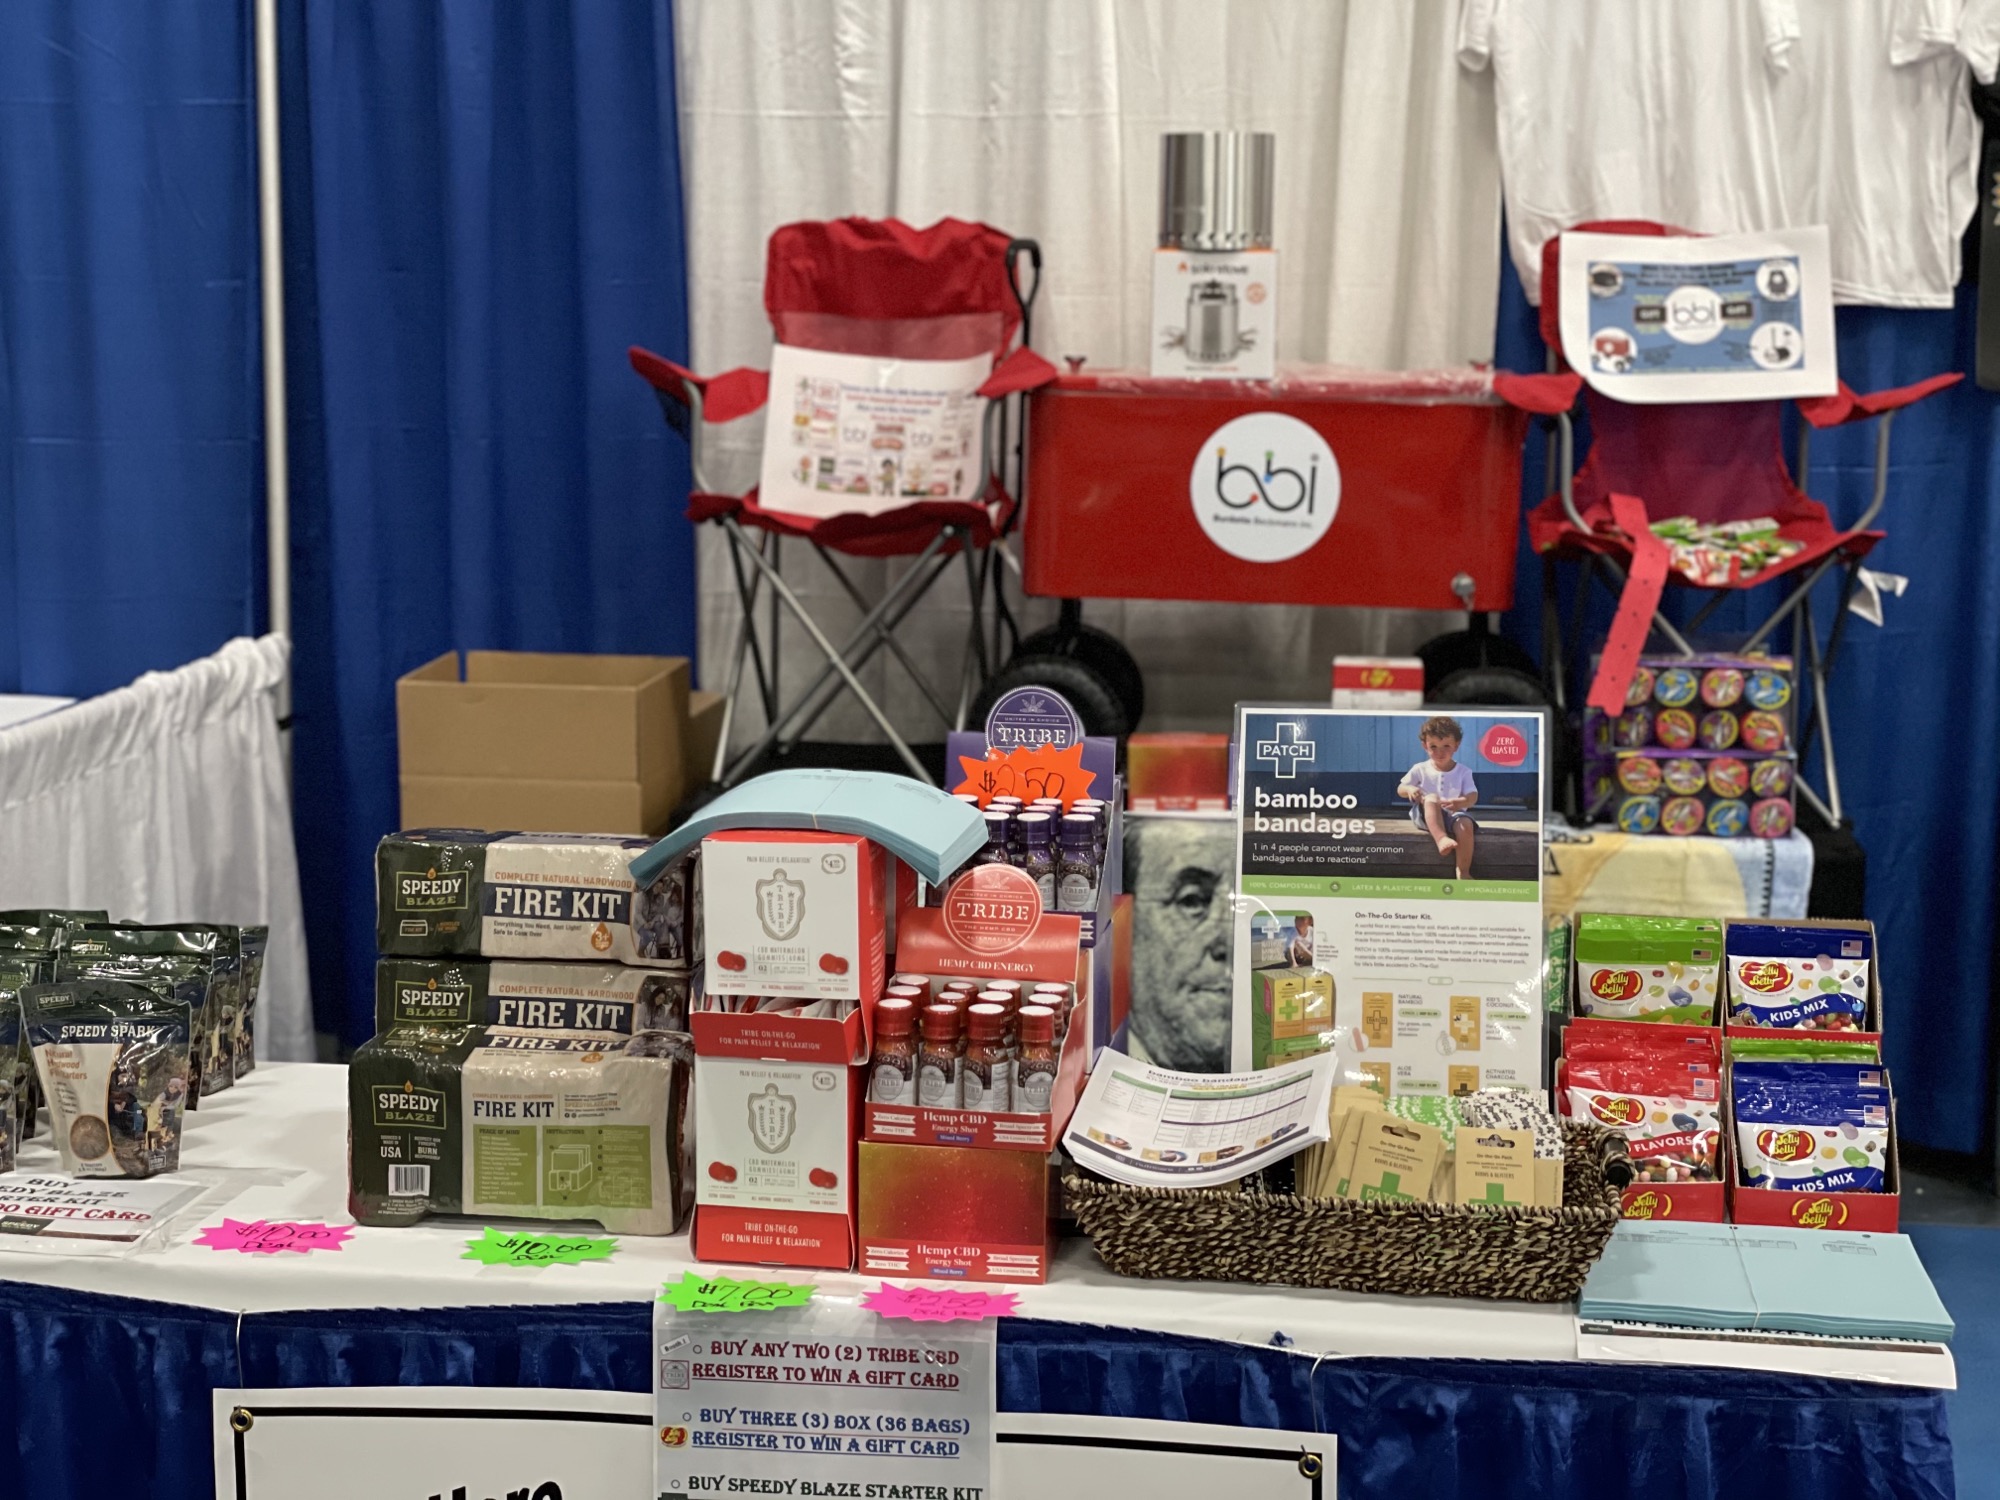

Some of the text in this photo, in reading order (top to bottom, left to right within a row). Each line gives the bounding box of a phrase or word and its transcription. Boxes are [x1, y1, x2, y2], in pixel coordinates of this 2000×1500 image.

[998, 728, 1066, 743] TRIBE
[1496, 737, 1515, 745] ZERO
[1263, 744, 1309, 757] PATCH
[1491, 745, 1519, 755] WASTE!
[1255, 787, 1358, 809] bamboo
[1255, 811, 1376, 838] bandages
[1278, 844, 1309, 853] people
[1253, 854, 1295, 864] bandages
[402, 879, 461, 895] SPEEDY
[495, 872, 632, 888] COMPLETE NATURAL HARDWOOD
[406, 896, 457, 906] BLAZE
[494, 887, 622, 919] FIRE KIT
[957, 903, 1029, 920] TRIBE
[494, 921, 523, 929] Everything
[939, 958, 1035, 973] HEMP CBD ENERGY
[1607, 970, 1629, 985] Jelly
[1749, 975, 1775, 992] Belly
[39, 995, 70, 1003] SPEEDY
[401, 989, 464, 1007] SPEEDY
[499, 985, 634, 1000] COMPLETE NATURAL HARDWOOD
[1598, 983, 1624, 1000] Belly
[406, 1008, 458, 1017] BLAZE
[498, 1000, 624, 1031] FIRE KIT
[1770, 999, 1829, 1022] KIDS MIX
[61, 1025, 157, 1038] SPEEDY SPARK
[741, 1029, 795, 1039] TRIBE ON-THE-GO
[488, 1037, 620, 1052] FIRE KIT
[782, 1042, 820, 1050] RELAXATION
[1148, 1070, 1199, 1083] bamboo
[379, 1094, 439, 1112] SPEEDY
[473, 1100, 516, 1118] FIRE
[523, 1102, 554, 1118] KIT
[1607, 1097, 1630, 1113] Jelly
[385, 1112, 435, 1122] BLAZE
[923, 1112, 987, 1125] Hemp CBD
[1601, 1110, 1626, 1125] Belly
[932, 1124, 978, 1134] Energy Shot
[1634, 1136, 1694, 1152] FLAVORS
[1776, 1129, 1800, 1145] Jelly
[380, 1146, 401, 1158] USA
[418, 1147, 437, 1155] BURN
[1773, 1145, 1796, 1161] Belly
[26, 1178, 82, 1188] BUY
[1792, 1172, 1855, 1192] KIDS MIX
[64, 1197, 107, 1205] KIT
[1634, 1191, 1658, 1208] Jelly
[1809, 1198, 1833, 1216] Jelly
[25, 1206, 151, 1219] GIFT CARD
[1624, 1205, 1653, 1220] Belly
[745, 1222, 798, 1234] TRIBE ON-THE-GO
[1799, 1213, 1828, 1230] Belly
[722, 1233, 820, 1247] FOR PAIN RELIEF & RELAXATION
[917, 1245, 980, 1258] Hemp CBD
[925, 1257, 951, 1266] Energy
[711, 1339, 919, 1363] BUY ANY TWO (2) TRIBE
[692, 1363, 959, 1388] REGISTER TO WIN A GIFT CARD
[700, 1407, 970, 1435] BUY THREE (3) BOX (36 BAGS)
[692, 1431, 778, 1450] REGISTER
[783, 1435, 806, 1449] TO
[810, 1434, 842, 1451] WIN
[847, 1438, 861, 1452] A
[866, 1439, 906, 1453] GIFT
[910, 1441, 959, 1456] CARD
[688, 1475, 983, 1500] BUY SPEEDY BLAZE STARTER KIT
